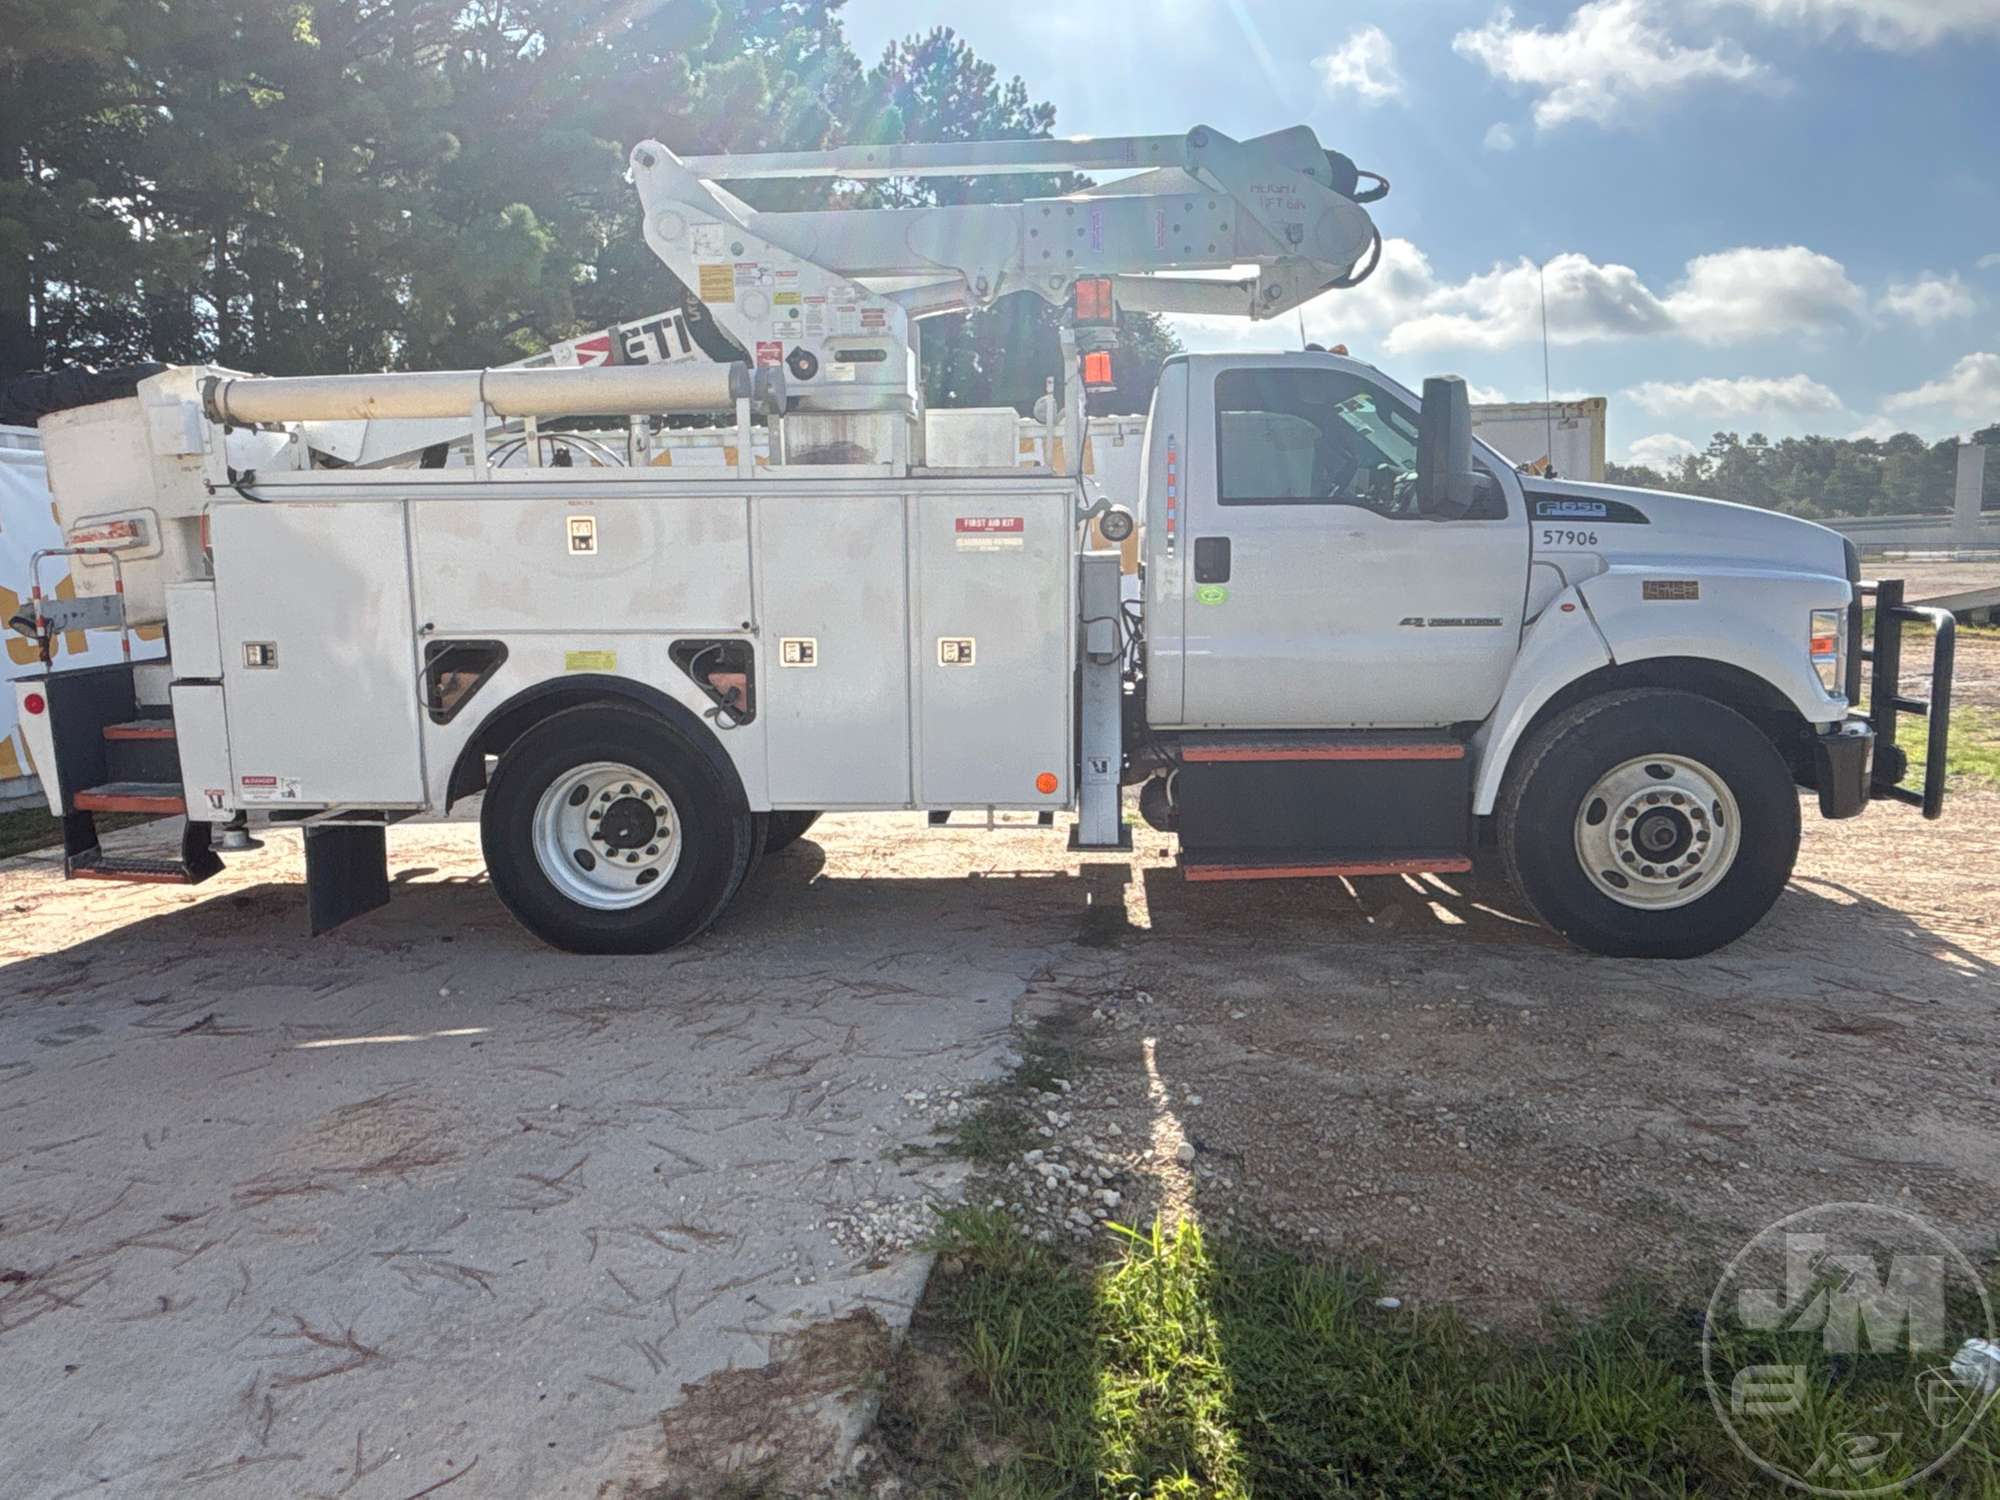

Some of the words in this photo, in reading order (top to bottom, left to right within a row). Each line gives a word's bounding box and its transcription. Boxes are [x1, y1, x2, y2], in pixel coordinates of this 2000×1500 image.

[964, 518, 986, 528] FIRST
[988, 518, 1001, 527] AID
[1002, 518, 1015, 527] KIT
[1543, 529, 1598, 546] 57906
